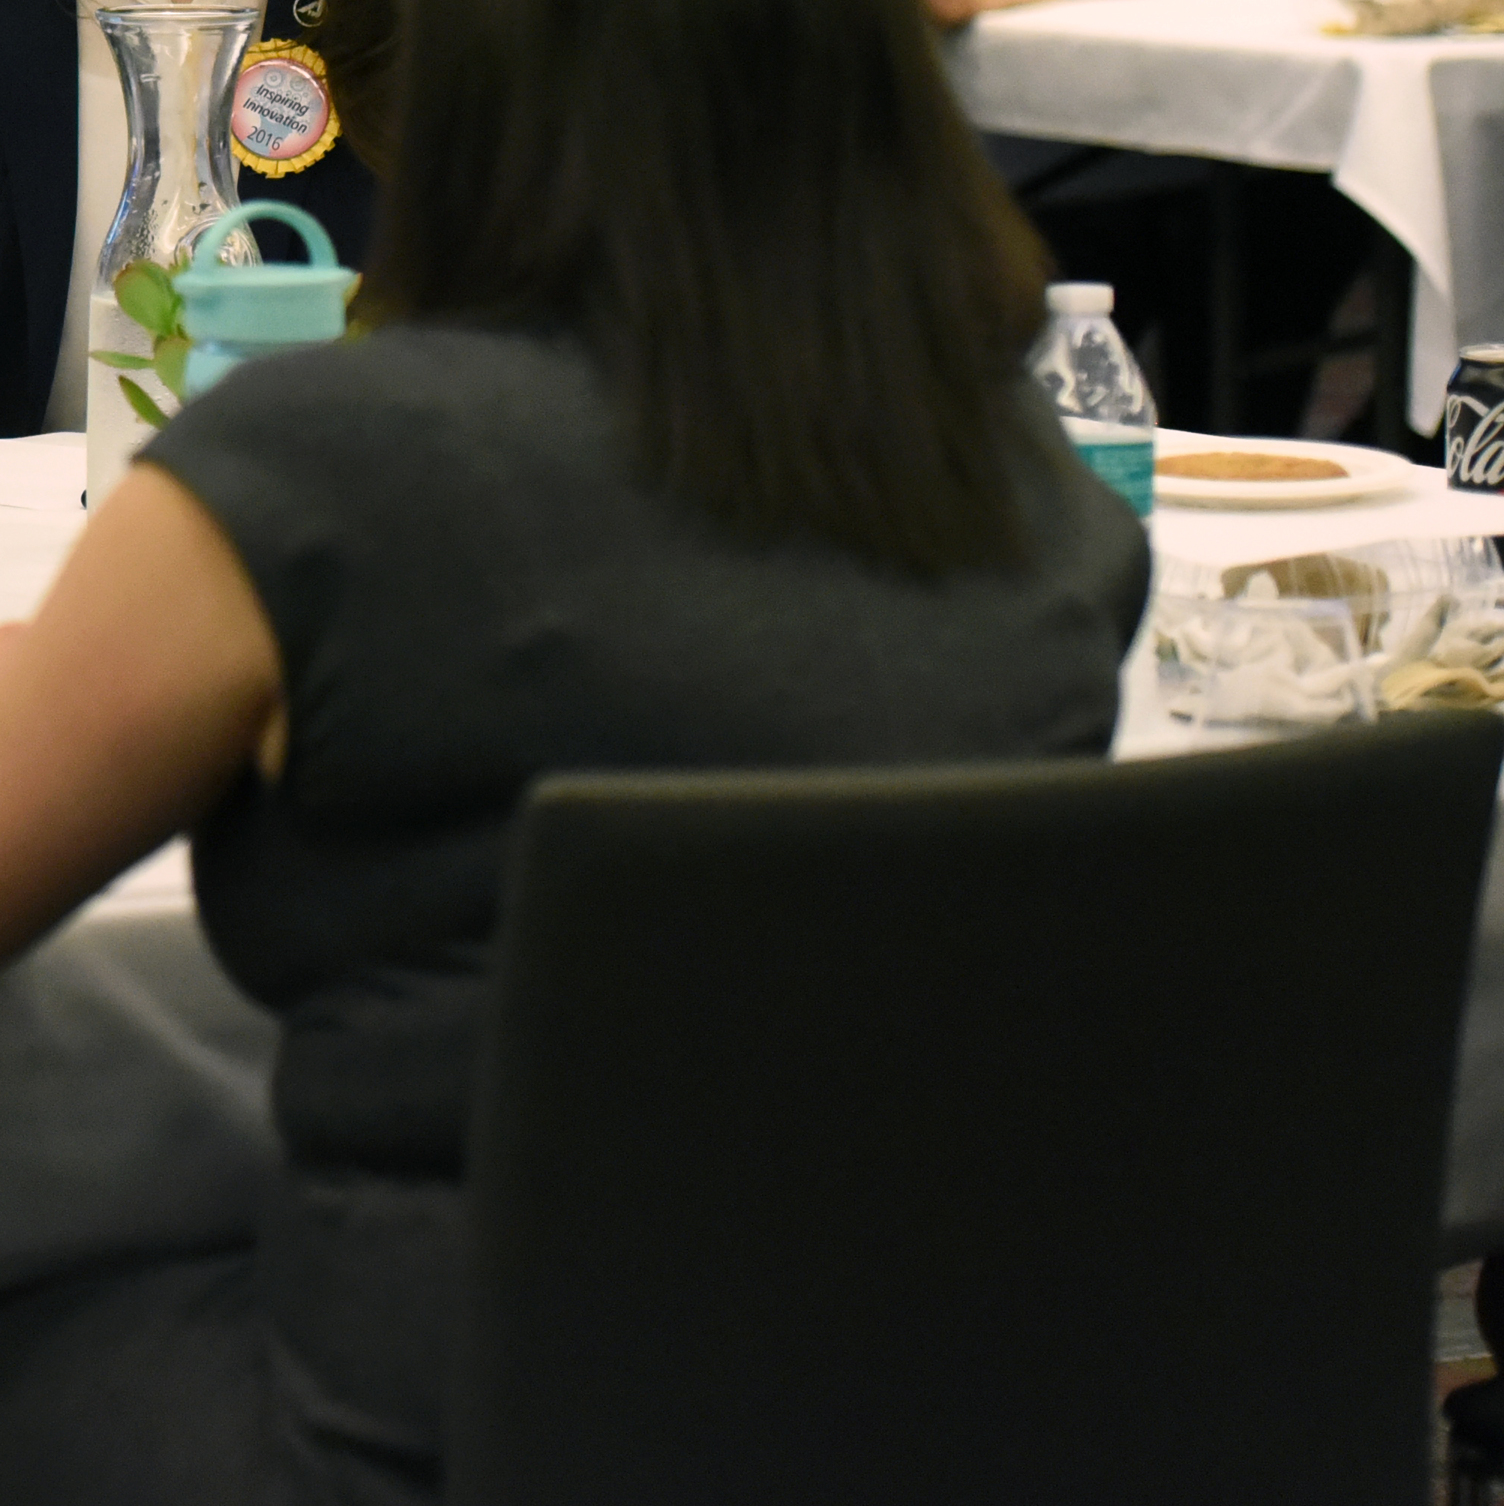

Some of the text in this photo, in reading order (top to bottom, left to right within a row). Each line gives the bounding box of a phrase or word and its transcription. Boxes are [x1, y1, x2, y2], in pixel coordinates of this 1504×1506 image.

[242, 98, 308, 134] Innovation
[256, 84, 309, 117] Inspiring
[246, 125, 283, 151] 2016
